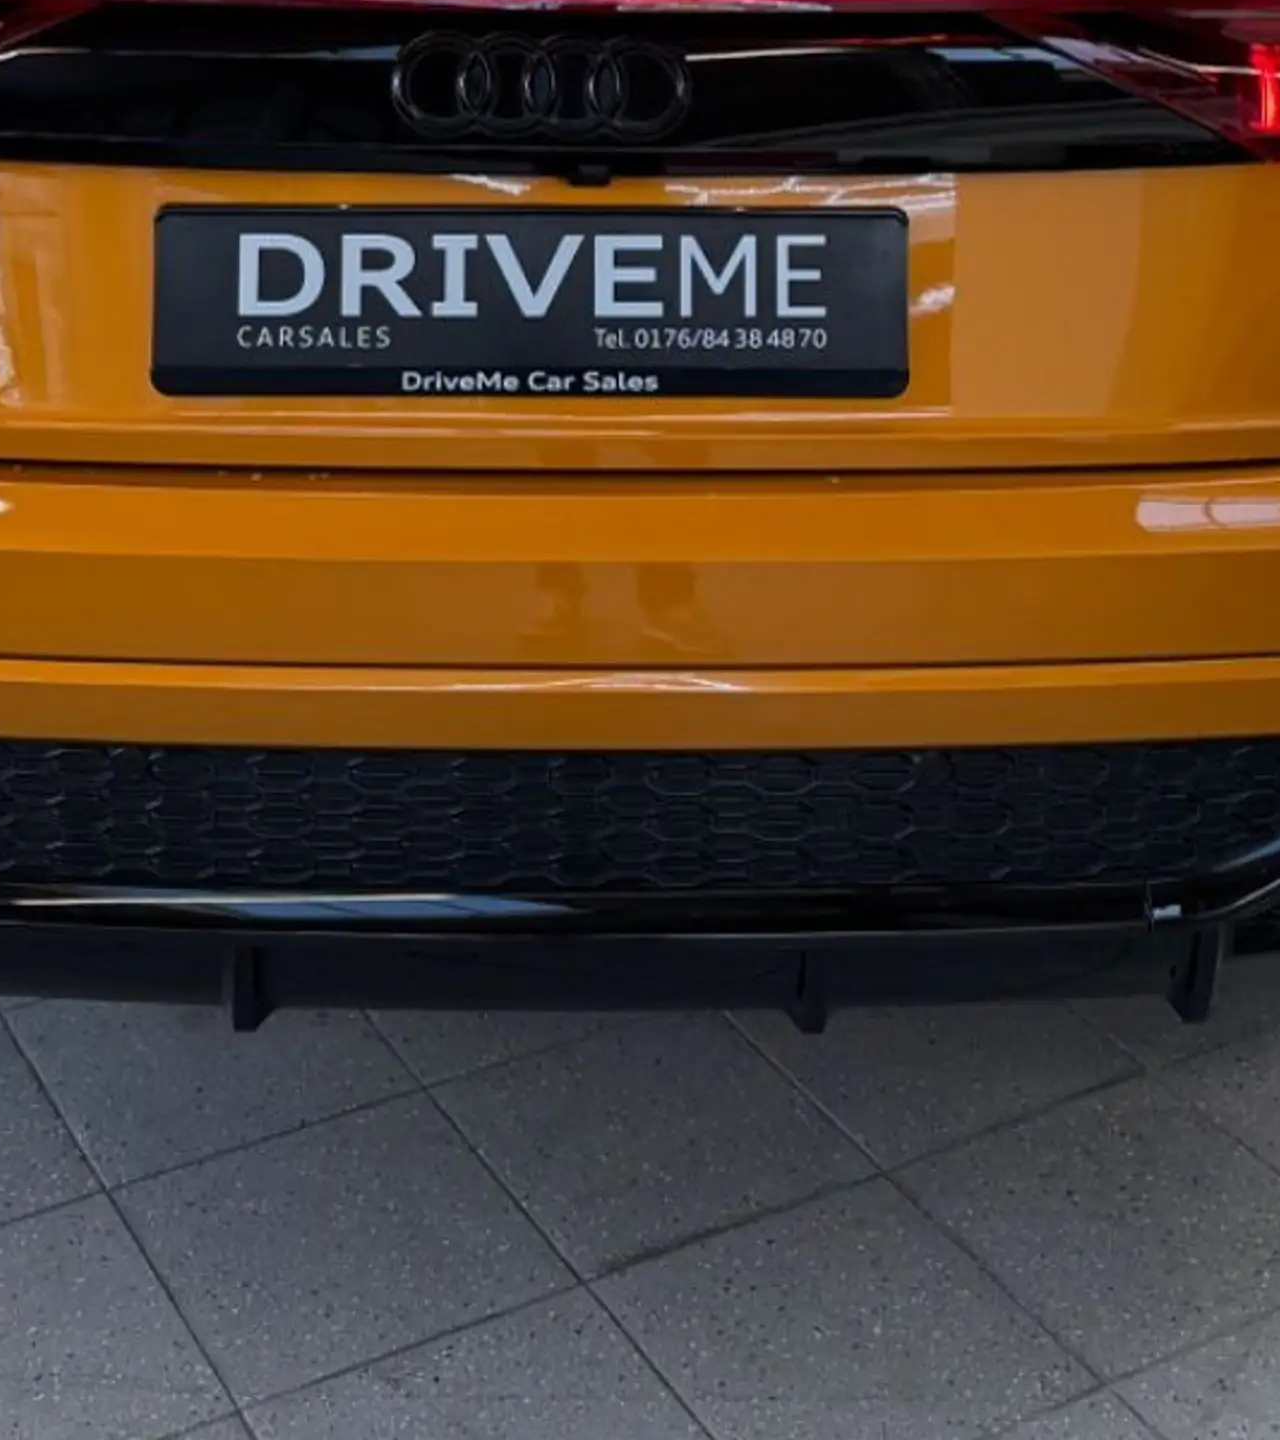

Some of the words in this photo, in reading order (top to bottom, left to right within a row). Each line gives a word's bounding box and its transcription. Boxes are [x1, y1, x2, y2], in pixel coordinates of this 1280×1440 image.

[238, 233, 827, 317] DRIVEME
[236, 325, 392, 348] CARSALES
[594, 327, 630, 349] Tel.
[401, 371, 520, 392] DriveMe
[527, 371, 575, 392] Car
[582, 371, 659, 392] Sales
